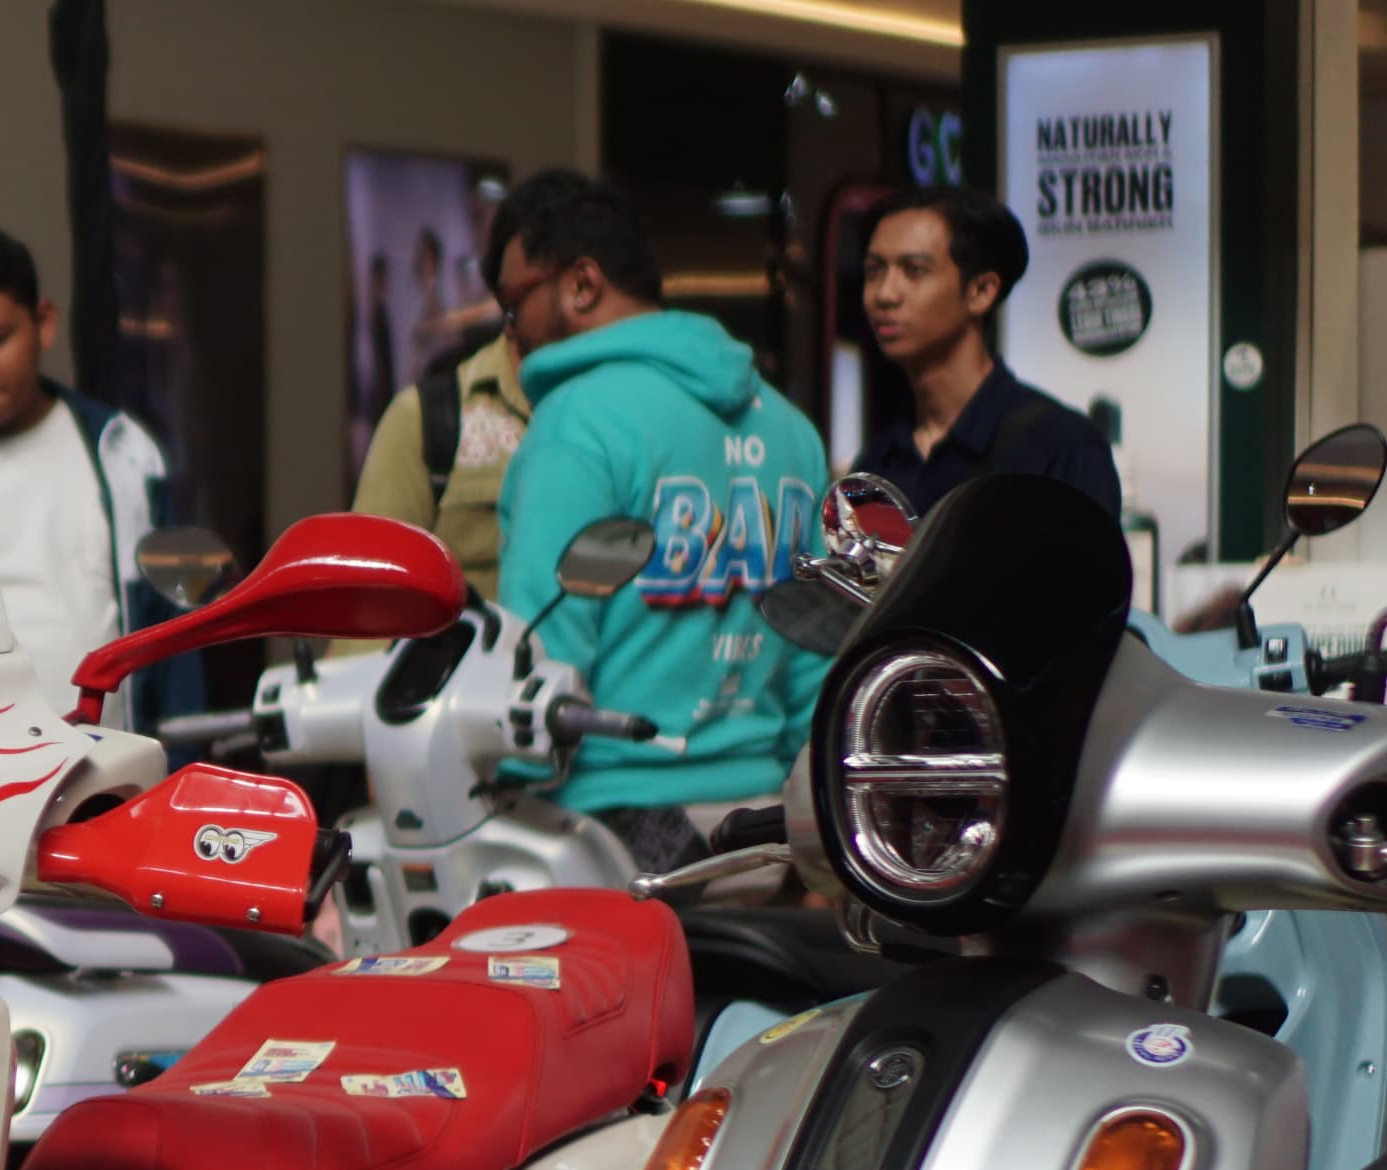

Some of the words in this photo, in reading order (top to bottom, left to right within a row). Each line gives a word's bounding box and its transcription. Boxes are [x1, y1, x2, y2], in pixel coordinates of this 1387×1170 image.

[1037, 111, 1173, 151] NATURALLY
[1037, 163, 1174, 218] STRONG
[724, 435, 765, 466] NO
[635, 475, 817, 606] BAD
